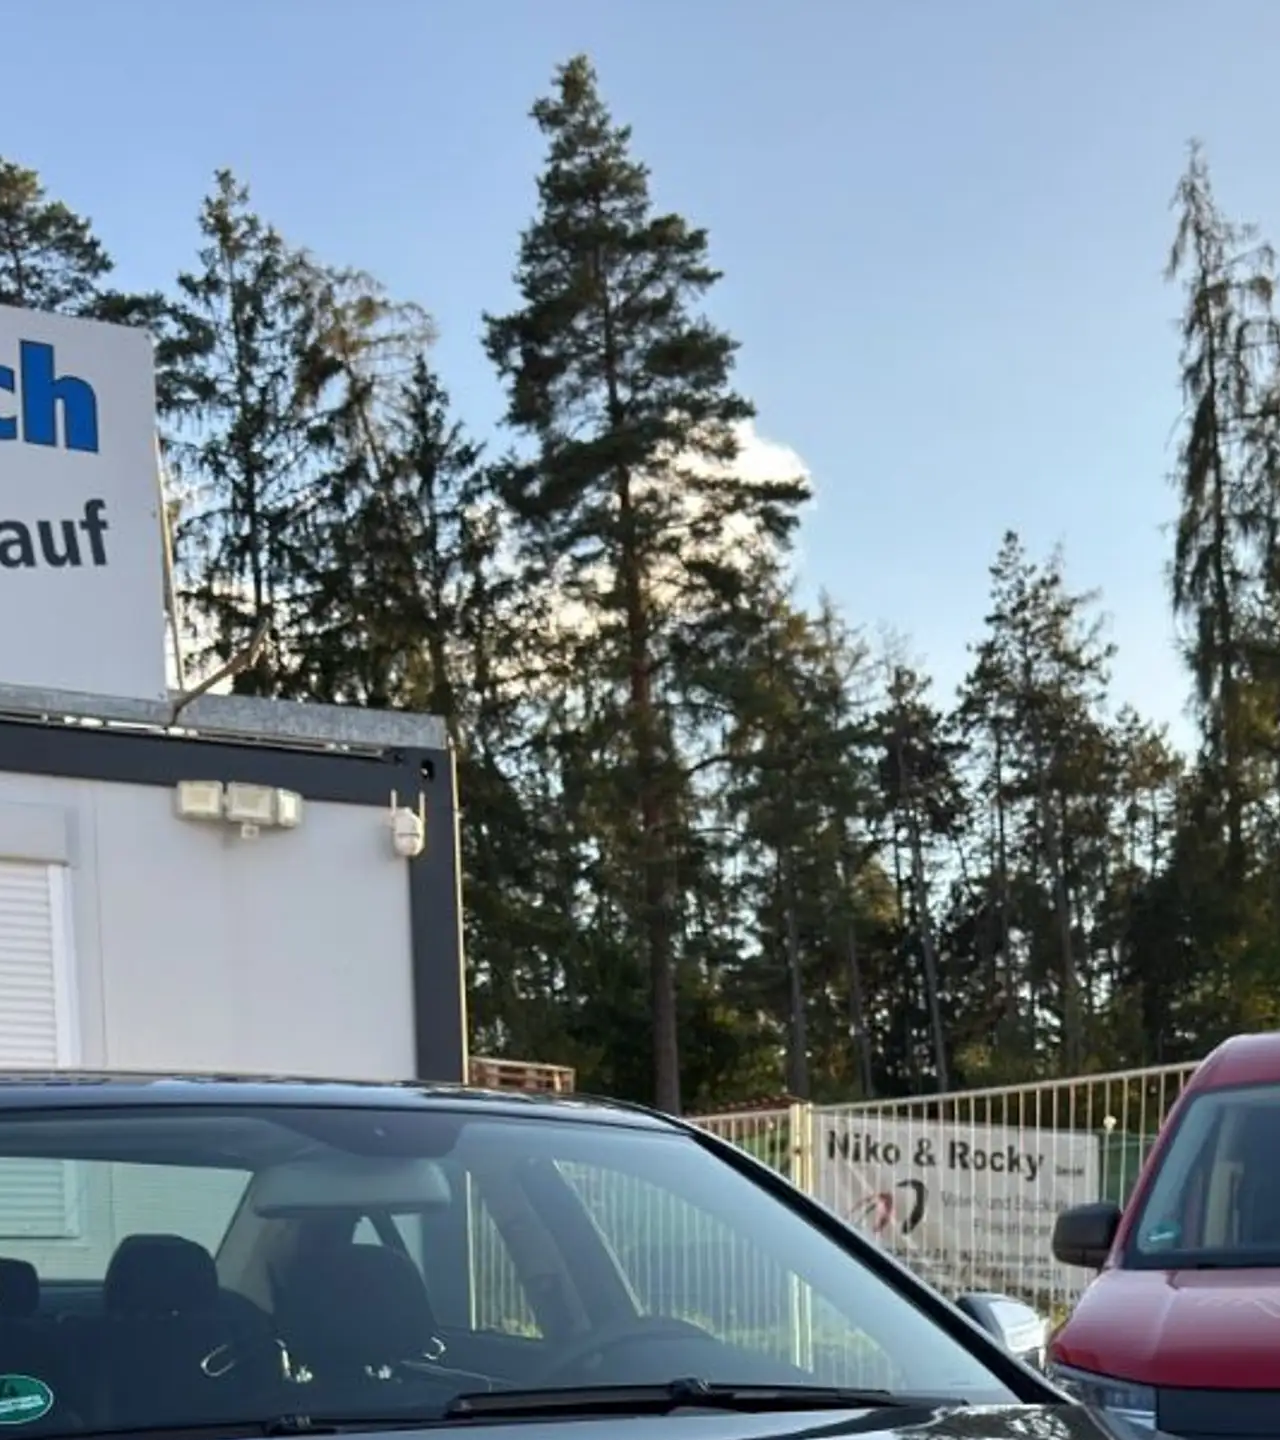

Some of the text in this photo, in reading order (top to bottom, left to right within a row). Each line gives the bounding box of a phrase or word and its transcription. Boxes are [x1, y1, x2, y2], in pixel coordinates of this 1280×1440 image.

[827, 1129, 1044, 1182] Niko & Rocky
